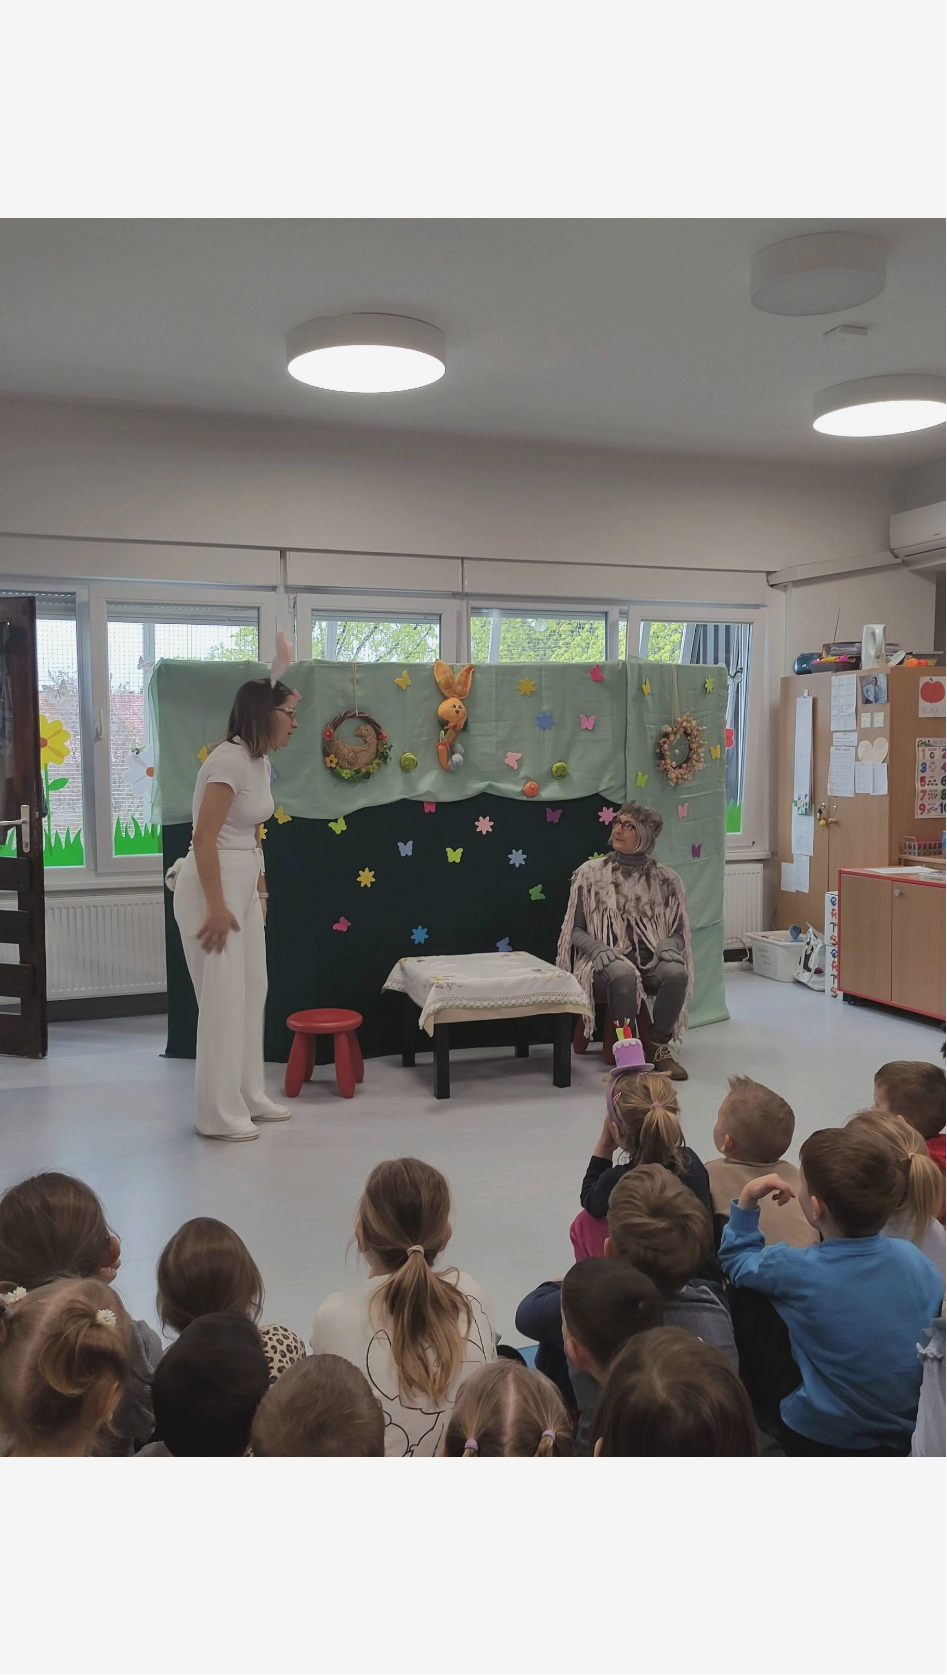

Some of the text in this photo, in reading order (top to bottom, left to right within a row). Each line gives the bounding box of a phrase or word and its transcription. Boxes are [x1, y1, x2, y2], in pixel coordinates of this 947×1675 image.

[921, 748, 926, 759] 1
[920, 762, 927, 773] 3
[919, 776, 926, 787] 5
[920, 789, 927, 800] 7
[918, 803, 926, 815] 9
